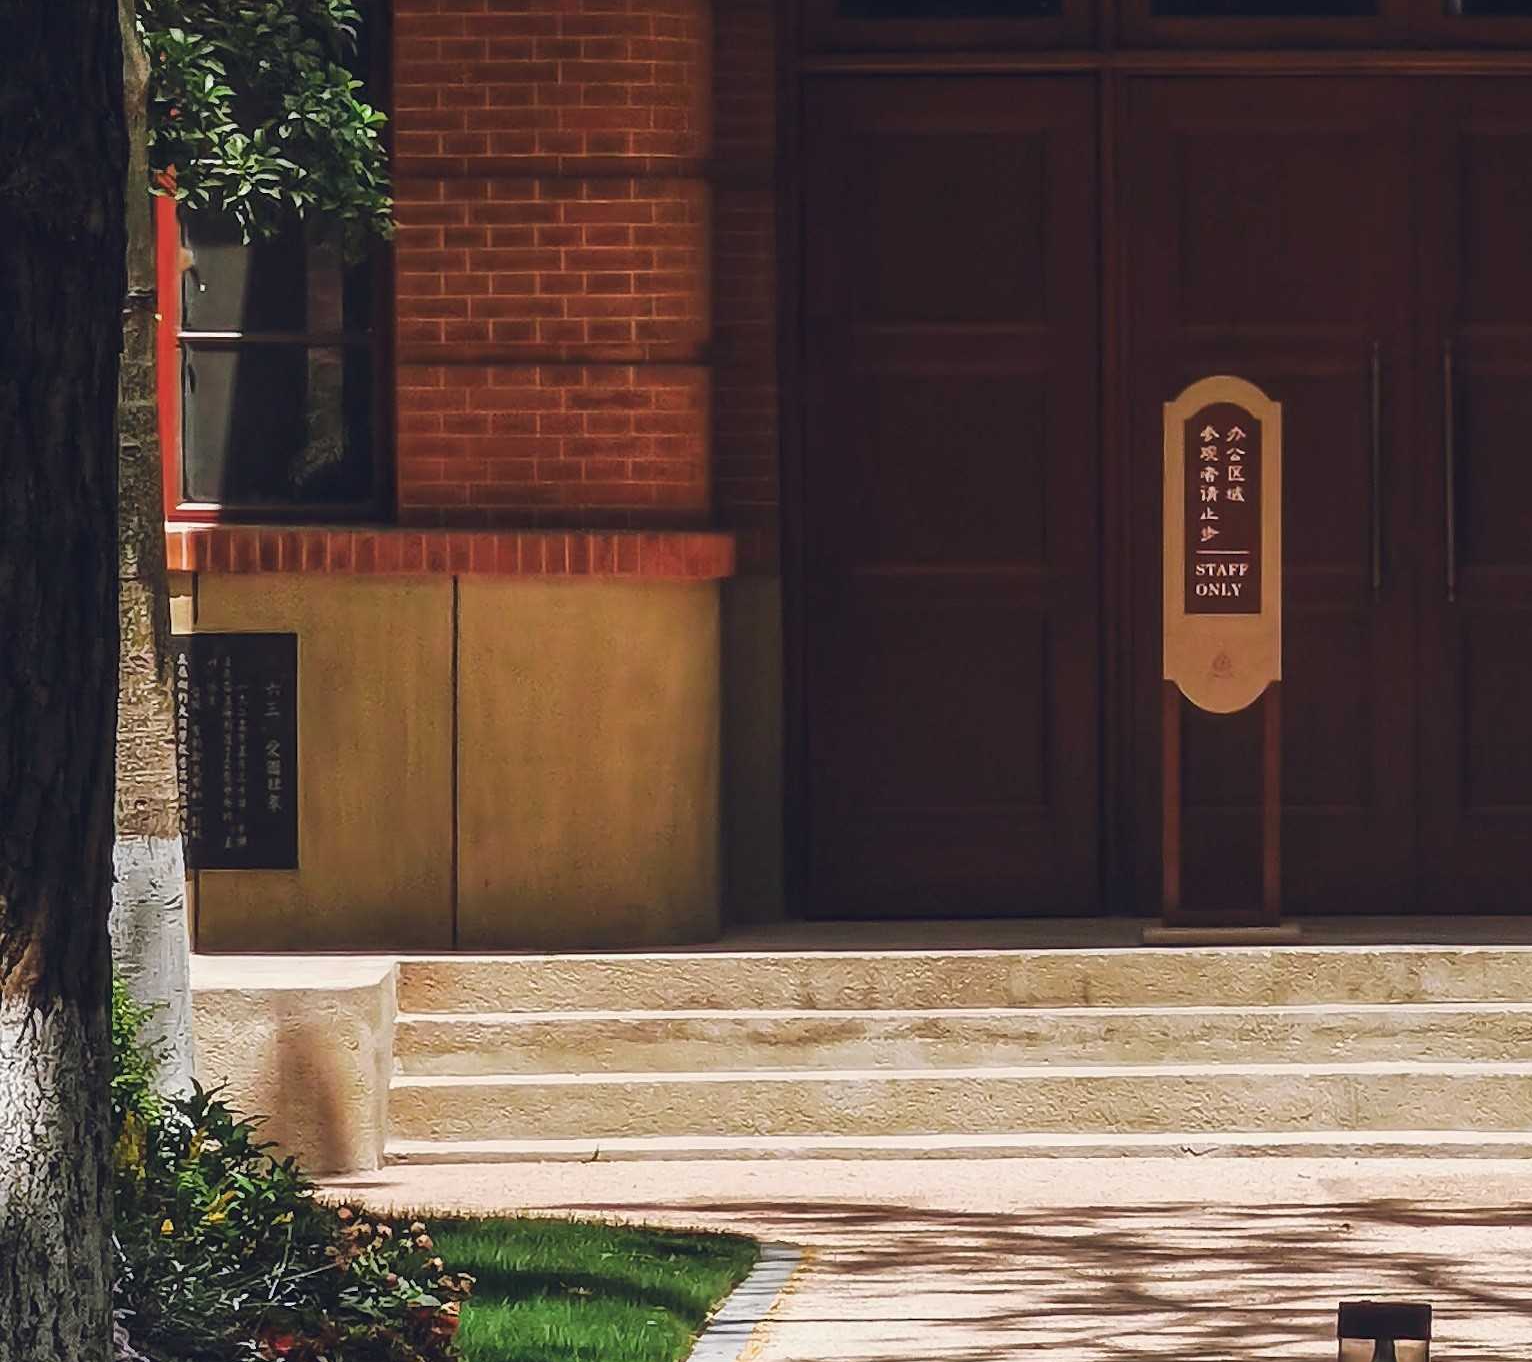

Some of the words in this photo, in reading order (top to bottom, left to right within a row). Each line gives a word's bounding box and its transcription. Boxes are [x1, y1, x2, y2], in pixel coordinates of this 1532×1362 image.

[1226, 425, 1246, 502] 办公区域
[1195, 563, 1249, 576] STAFF
[1195, 583, 1242, 596] ONLY
